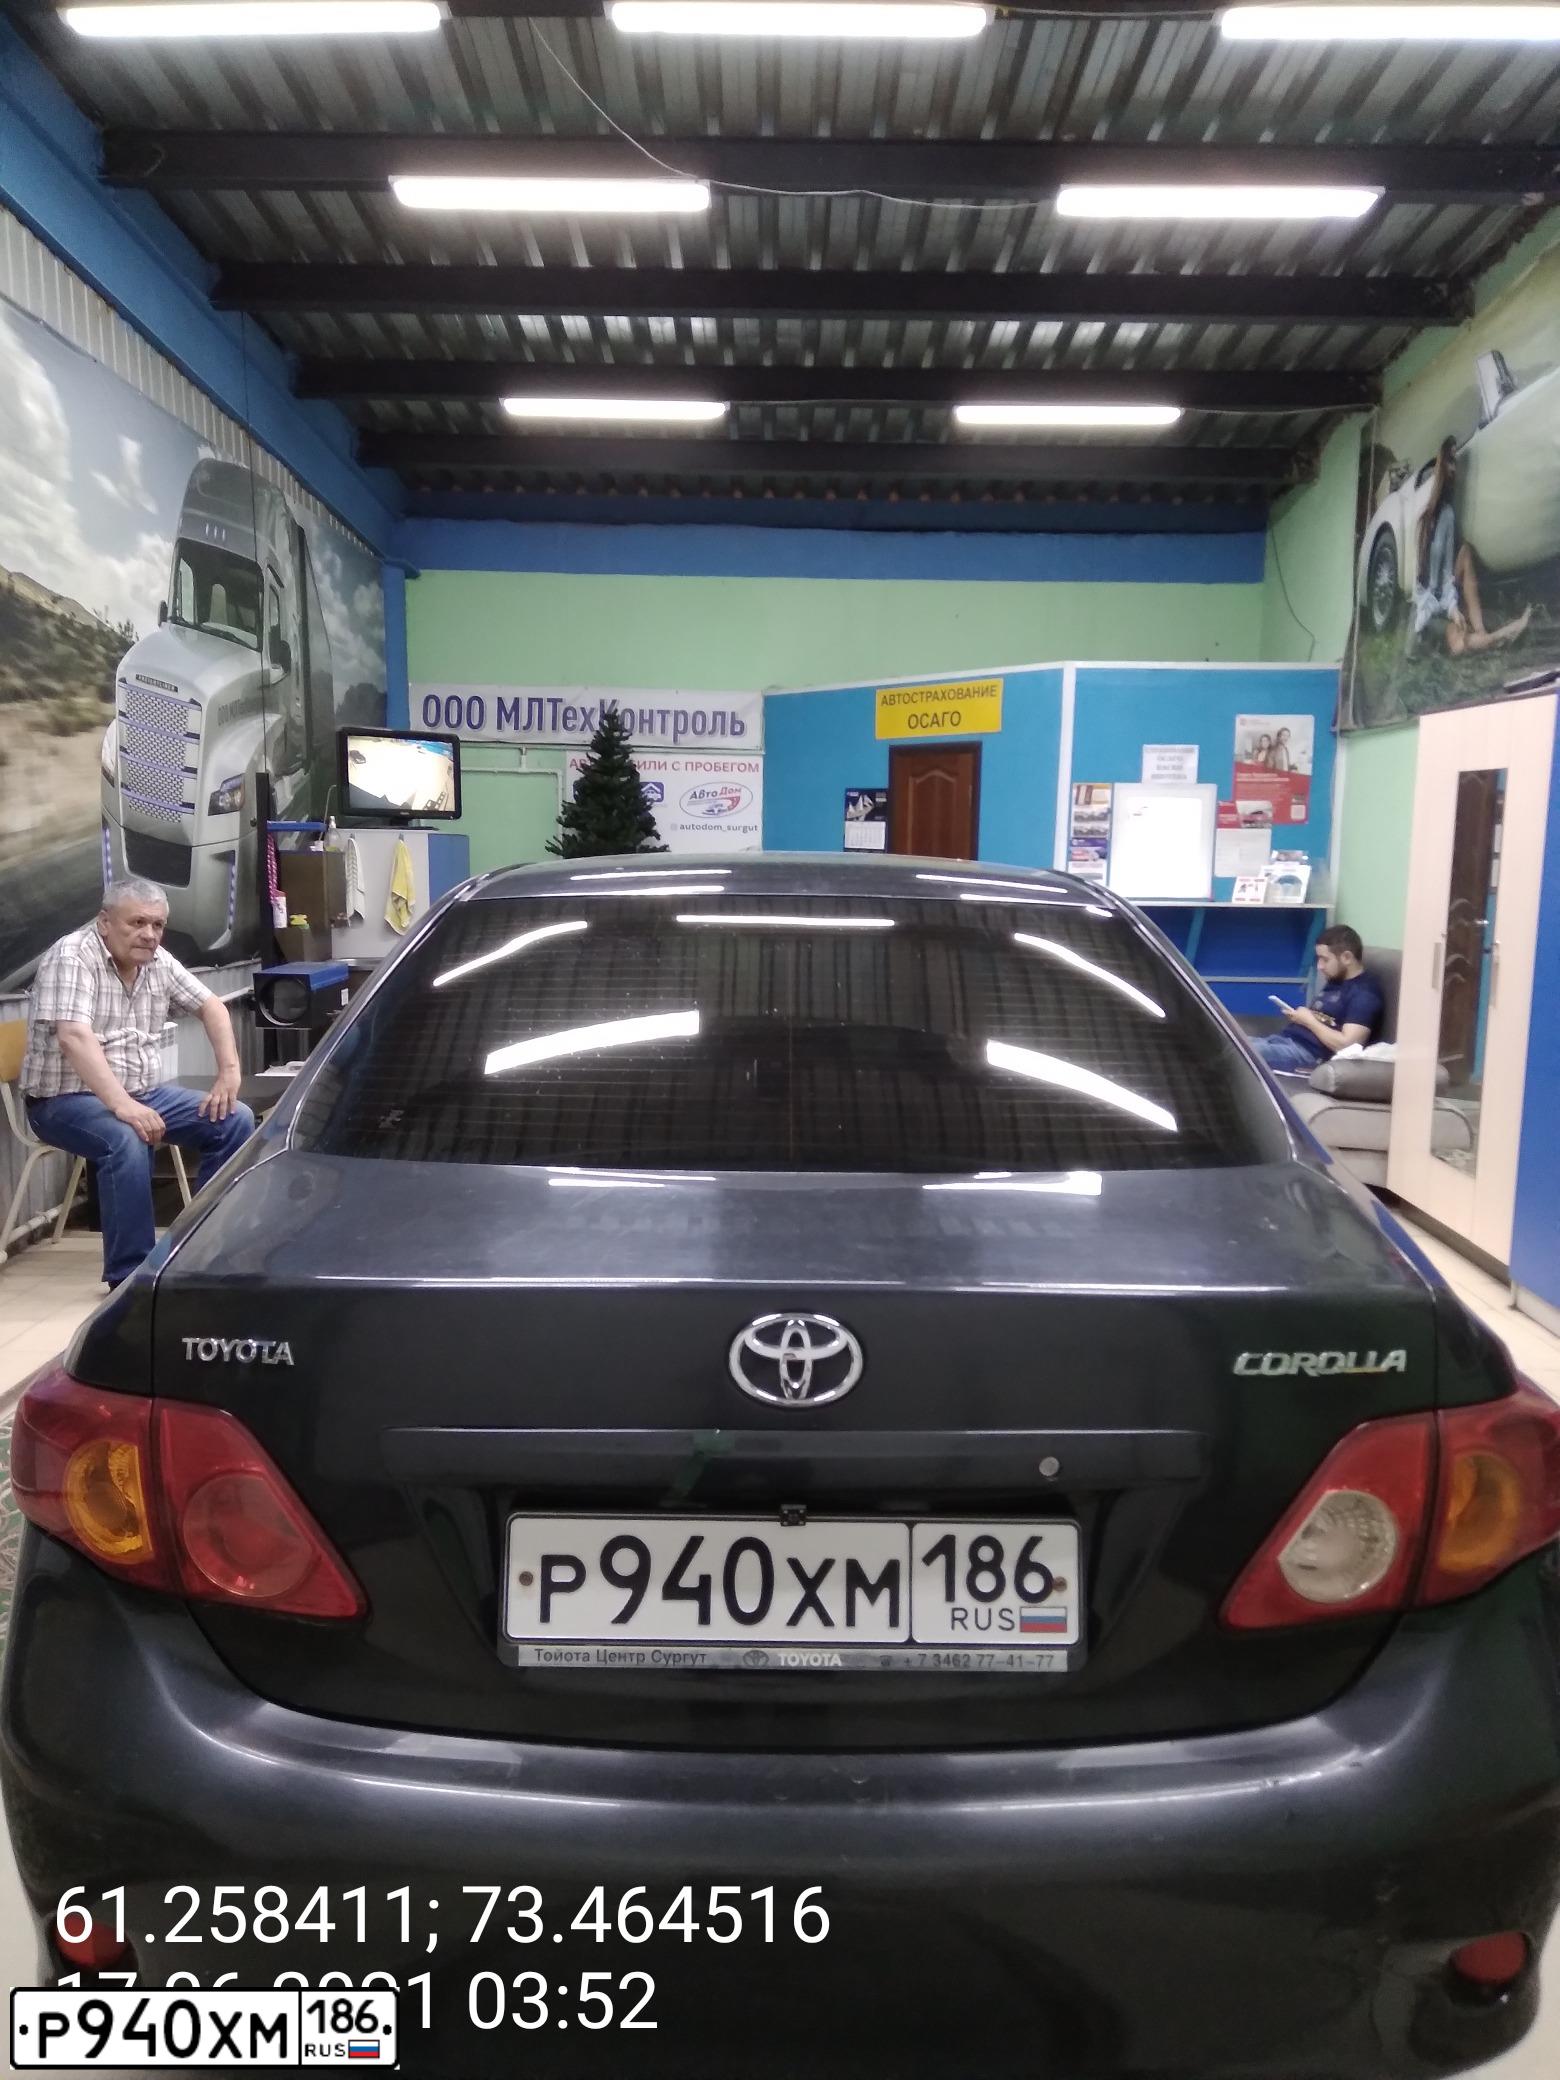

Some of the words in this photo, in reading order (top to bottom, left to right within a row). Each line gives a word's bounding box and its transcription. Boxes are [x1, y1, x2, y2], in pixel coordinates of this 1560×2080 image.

[880, 684, 998, 707] АВТОСТРАХОВАНИЕ
[422, 694, 486, 730] ООО
[907, 710, 962, 730] ОСАГО
[671, 761, 681, 772] С
[684, 761, 760, 773] ПРОБЕГОМ
[679, 823, 758, 834] autodom_surgut
[182, 1337, 295, 1366] TOYOTA
[1232, 1349, 1408, 1377] COROLLA
[921, 1534, 1054, 1604] 186
[951, 1607, 1015, 1632] RUS
[534, 1648, 591, 1663] Тойота
[596, 1649, 646, 1666] Центр
[650, 1650, 707, 1666] Сургут
[778, 1654, 843, 1667] TOYOTA
